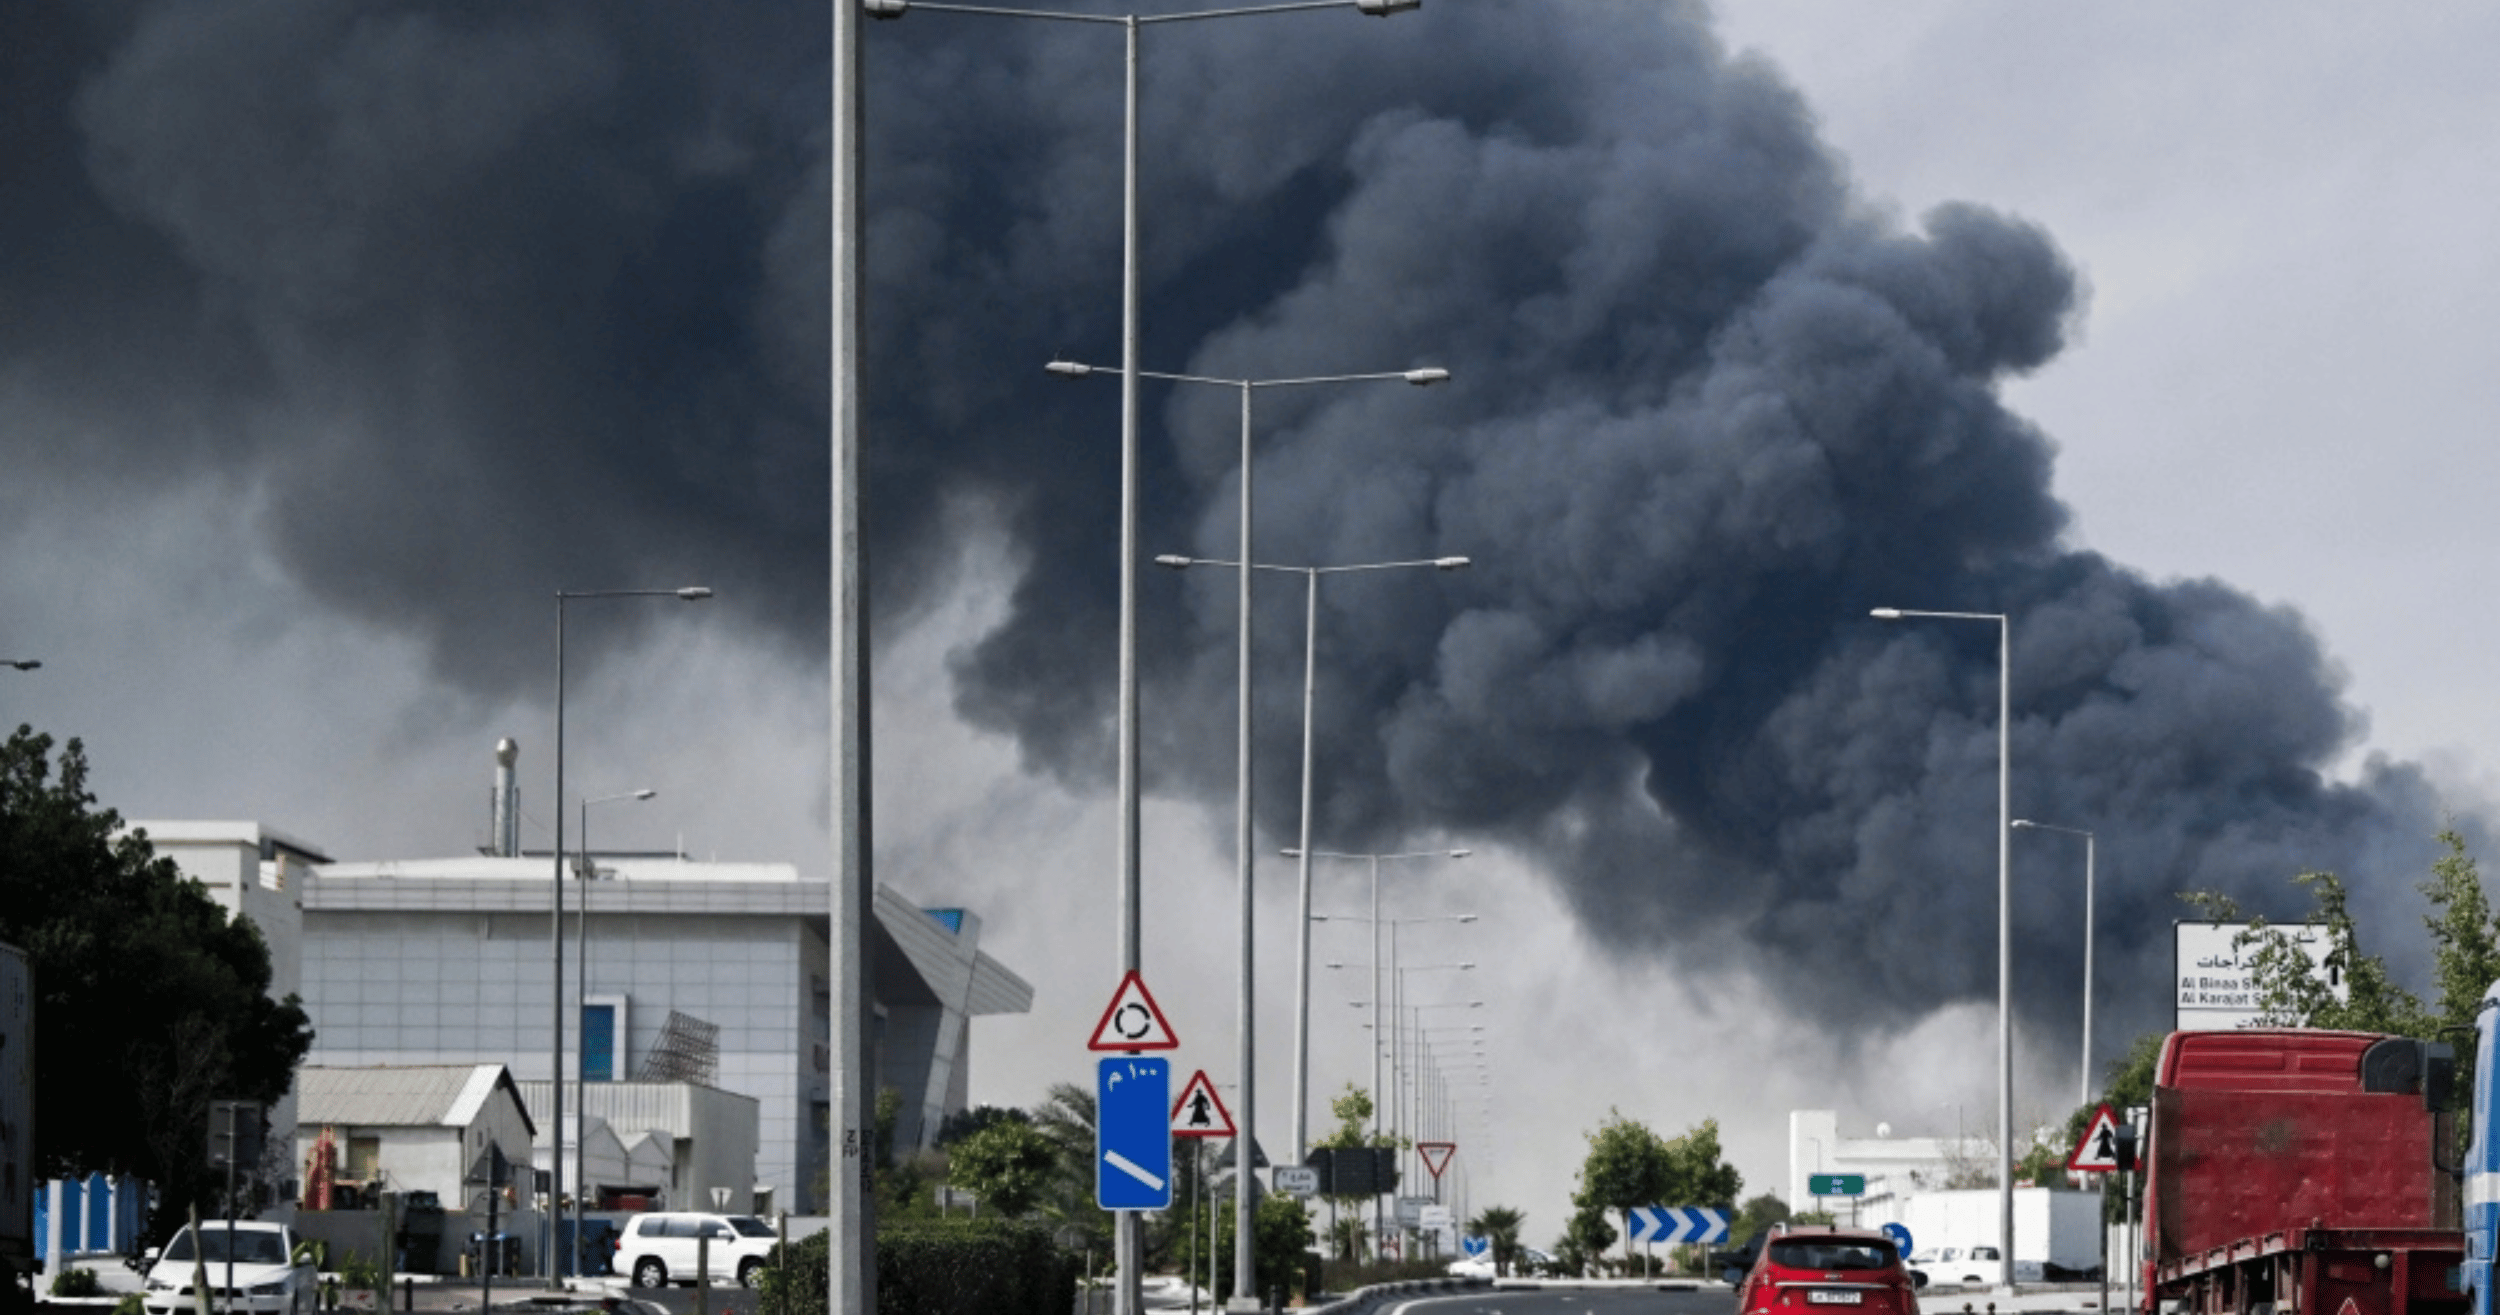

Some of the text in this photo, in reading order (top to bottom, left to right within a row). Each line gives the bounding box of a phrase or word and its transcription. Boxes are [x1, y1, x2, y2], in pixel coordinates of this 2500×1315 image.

[2181, 976, 2195, 989] Al
[2199, 976, 2239, 989] Binaa
[2181, 991, 2195, 1003] Al
[2199, 991, 2248, 1005] Karajat
